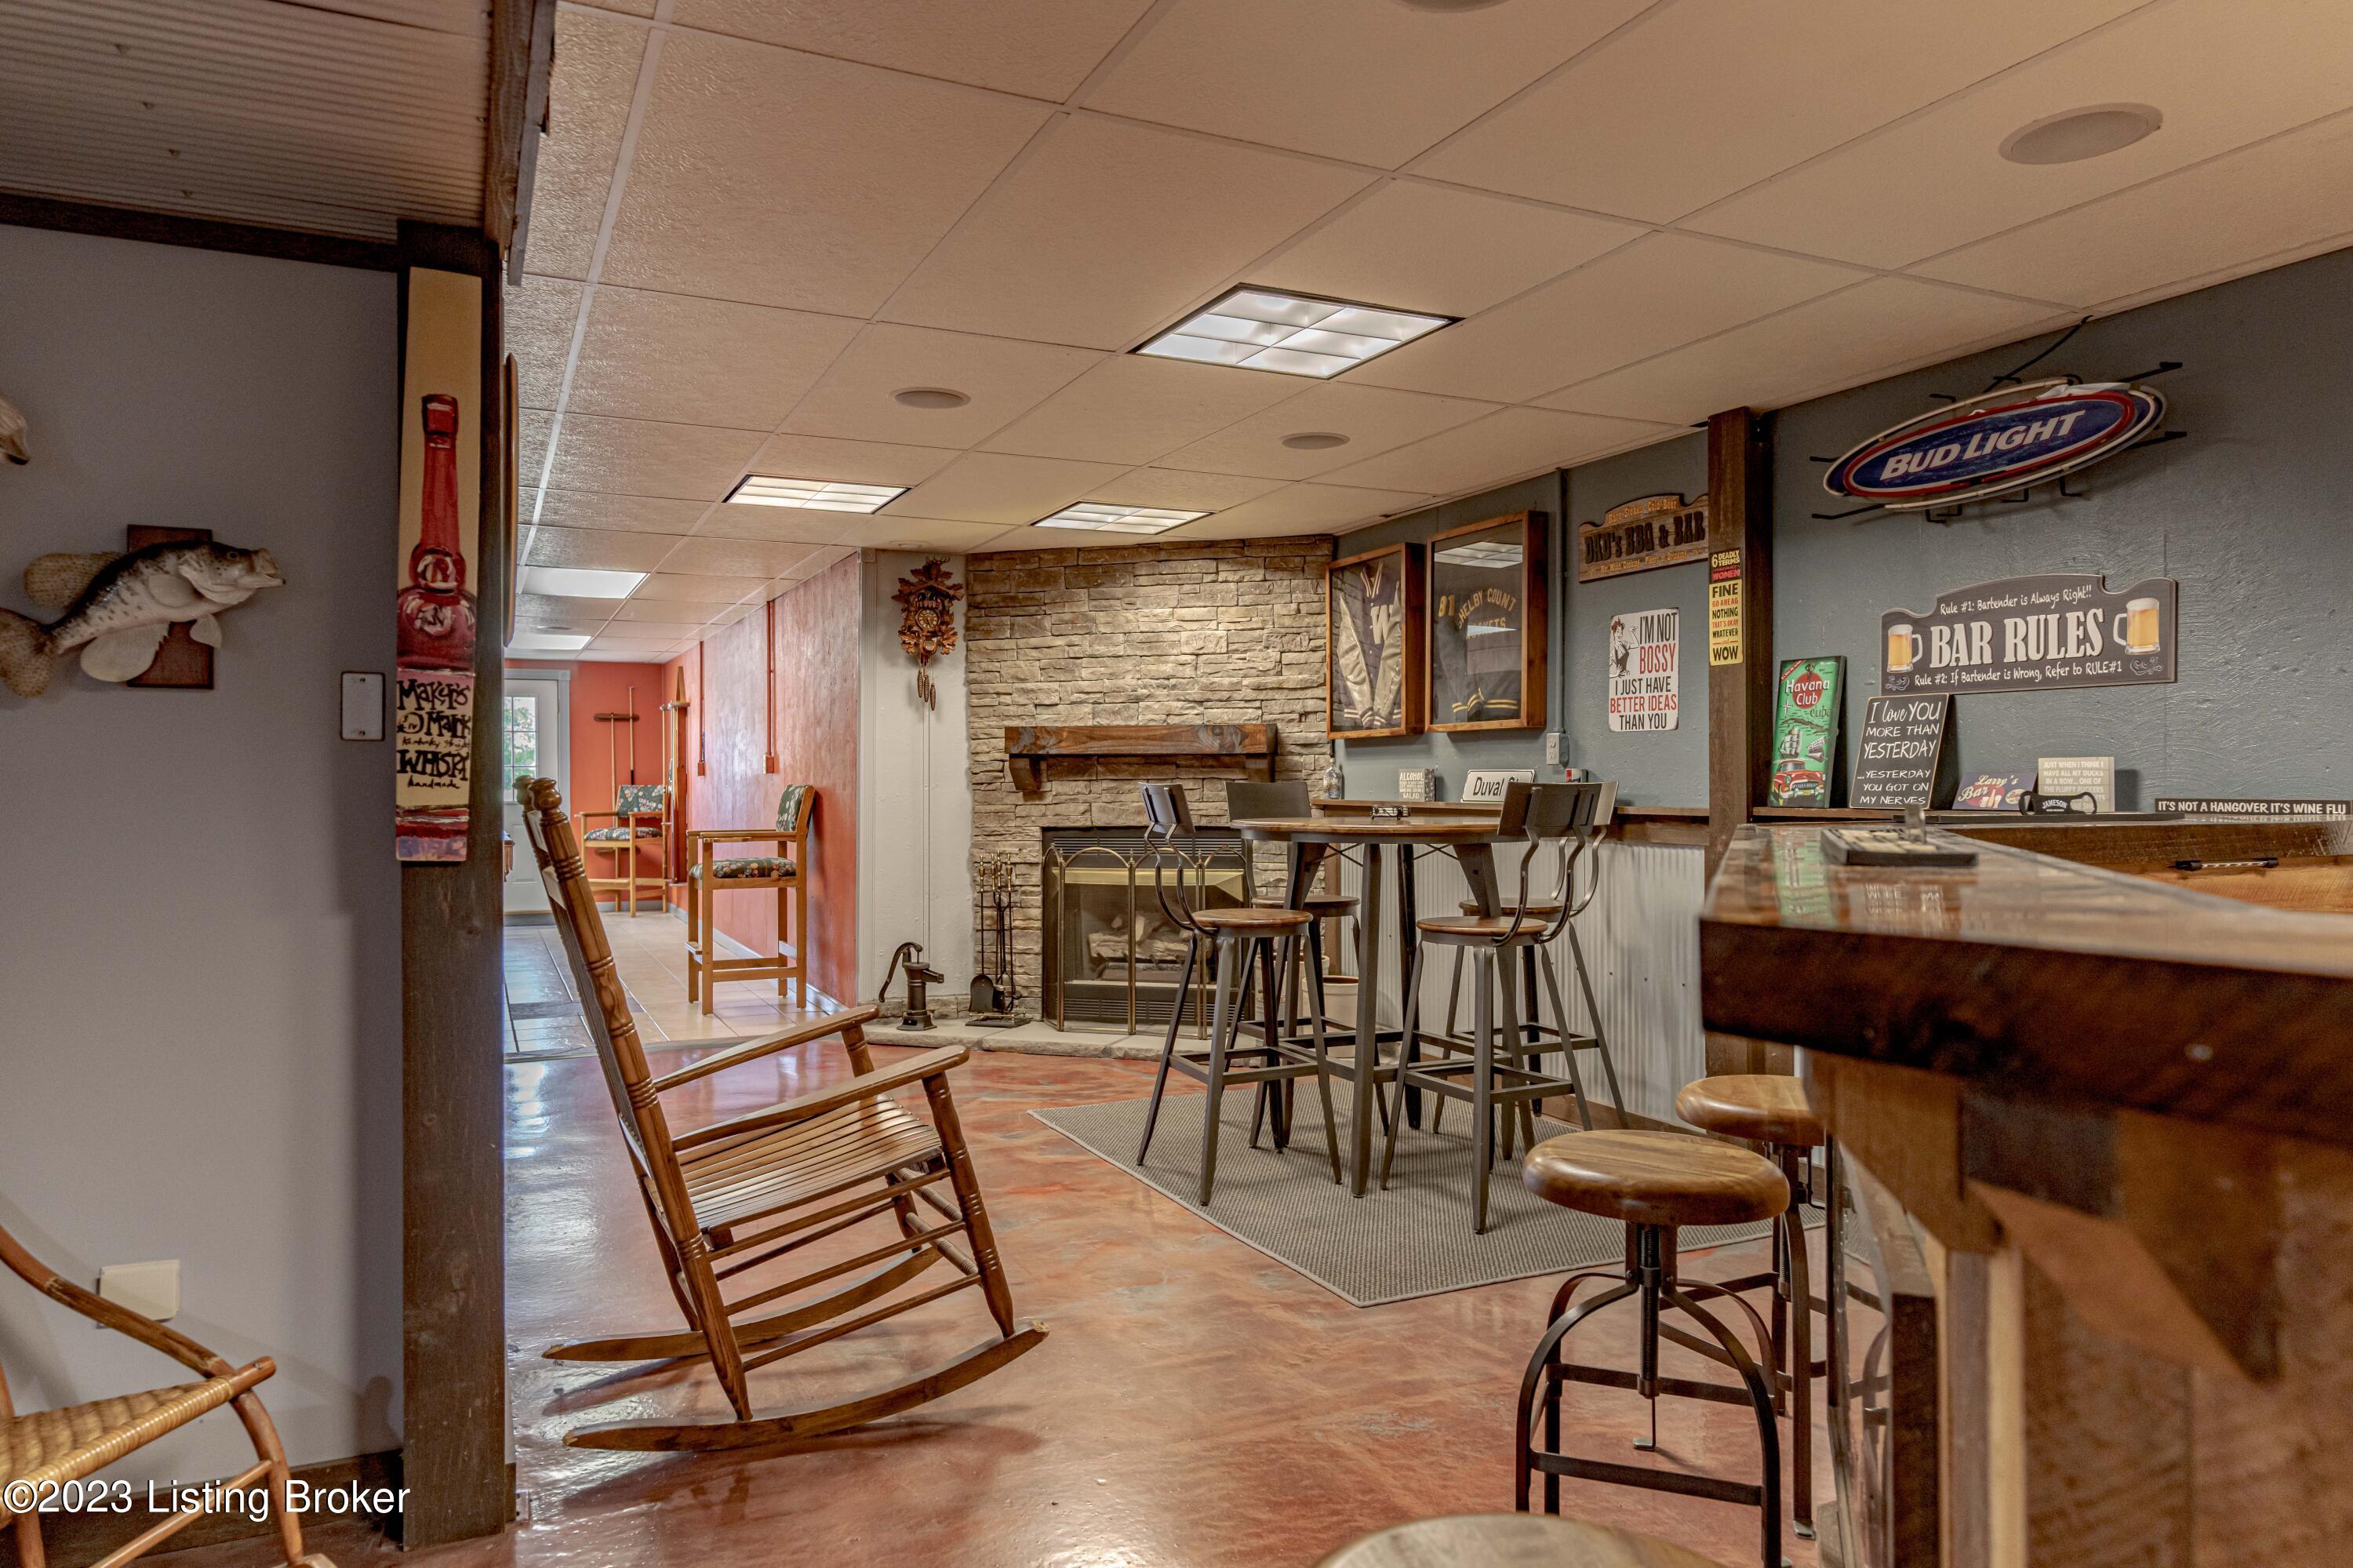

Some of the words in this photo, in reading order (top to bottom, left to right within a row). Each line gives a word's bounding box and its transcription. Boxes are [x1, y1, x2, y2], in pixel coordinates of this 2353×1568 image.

[1880, 442, 1961, 482] BUD
[1962, 410, 2086, 460] LIGHT
[1659, 525, 1670, 548] &
[1674, 511, 1705, 547] BAR
[1712, 554, 1718, 568] 6
[1718, 550, 1740, 560] DEADLY
[1718, 558, 1740, 566] TERMS
[1713, 569, 1740, 580] WOMEN
[1713, 583, 1738, 598] FINE
[1720, 597, 1738, 606] AHEAD
[1940, 603, 1958, 616] Rule
[1961, 601, 1975, 613] #1:
[1977, 595, 2018, 611] Bartender
[2020, 595, 2028, 606] is
[2031, 591, 2060, 609] Always
[2063, 584, 2092, 605] Right!!
[1712, 606, 1738, 619] NOTHING
[1640, 615, 1654, 644] I'M
[1657, 613, 1677, 642] NOT
[1713, 628, 1738, 638] WHATEVER
[1929, 620, 1993, 668] BAR
[2003, 608, 2104, 663] RULES
[1640, 643, 1675, 674] BOSSY
[1713, 646, 1738, 661] WOW
[1915, 675, 1932, 686] Rule
[1935, 673, 1947, 685] #2:
[1950, 669, 1959, 686] If
[1962, 667, 2001, 683] Bartender
[2004, 668, 2011, 680] is
[2013, 667, 2042, 682] Wrong,
[2046, 661, 2069, 680] Refer
[2073, 664, 2082, 675] to
[1620, 678, 1643, 695] JUST
[1646, 676, 1671, 693] HAVE
[1785, 679, 1830, 693] Havana
[1610, 696, 1645, 713] BETTER
[1648, 694, 1677, 711] IDEAS
[1796, 692, 1818, 705] Club
[1809, 705, 1831, 717] Cuba
[1868, 702, 1881, 723] I
[1882, 700, 1907, 722] love
[1908, 701, 1941, 722] YOU
[1620, 714, 1644, 730] THAN
[1647, 713, 1667, 729] YOU
[1866, 726, 1900, 737] MORE
[1906, 723, 1940, 736] THAN
[1864, 740, 1937, 759] YESTERDAY
[1399, 772, 1424, 780] ALCOHOL
[1975, 775, 2019, 788] Larry's
[1473, 777, 1504, 796] Duval
[1913, 783, 1929, 791] ON
[1958, 786, 1989, 801] Bar
[1860, 795, 1877, 804] MY
[1880, 795, 1926, 805] NERVES
[2042, 799, 2068, 809] JAMESON
[2158, 801, 2176, 811] IT'S
[2178, 801, 2198, 812] NOT
[2200, 802, 2208, 812] A
[2271, 802, 2290, 813] IT'S
[2293, 803, 2322, 814] WINE
[2326, 803, 2347, 815] FLU
